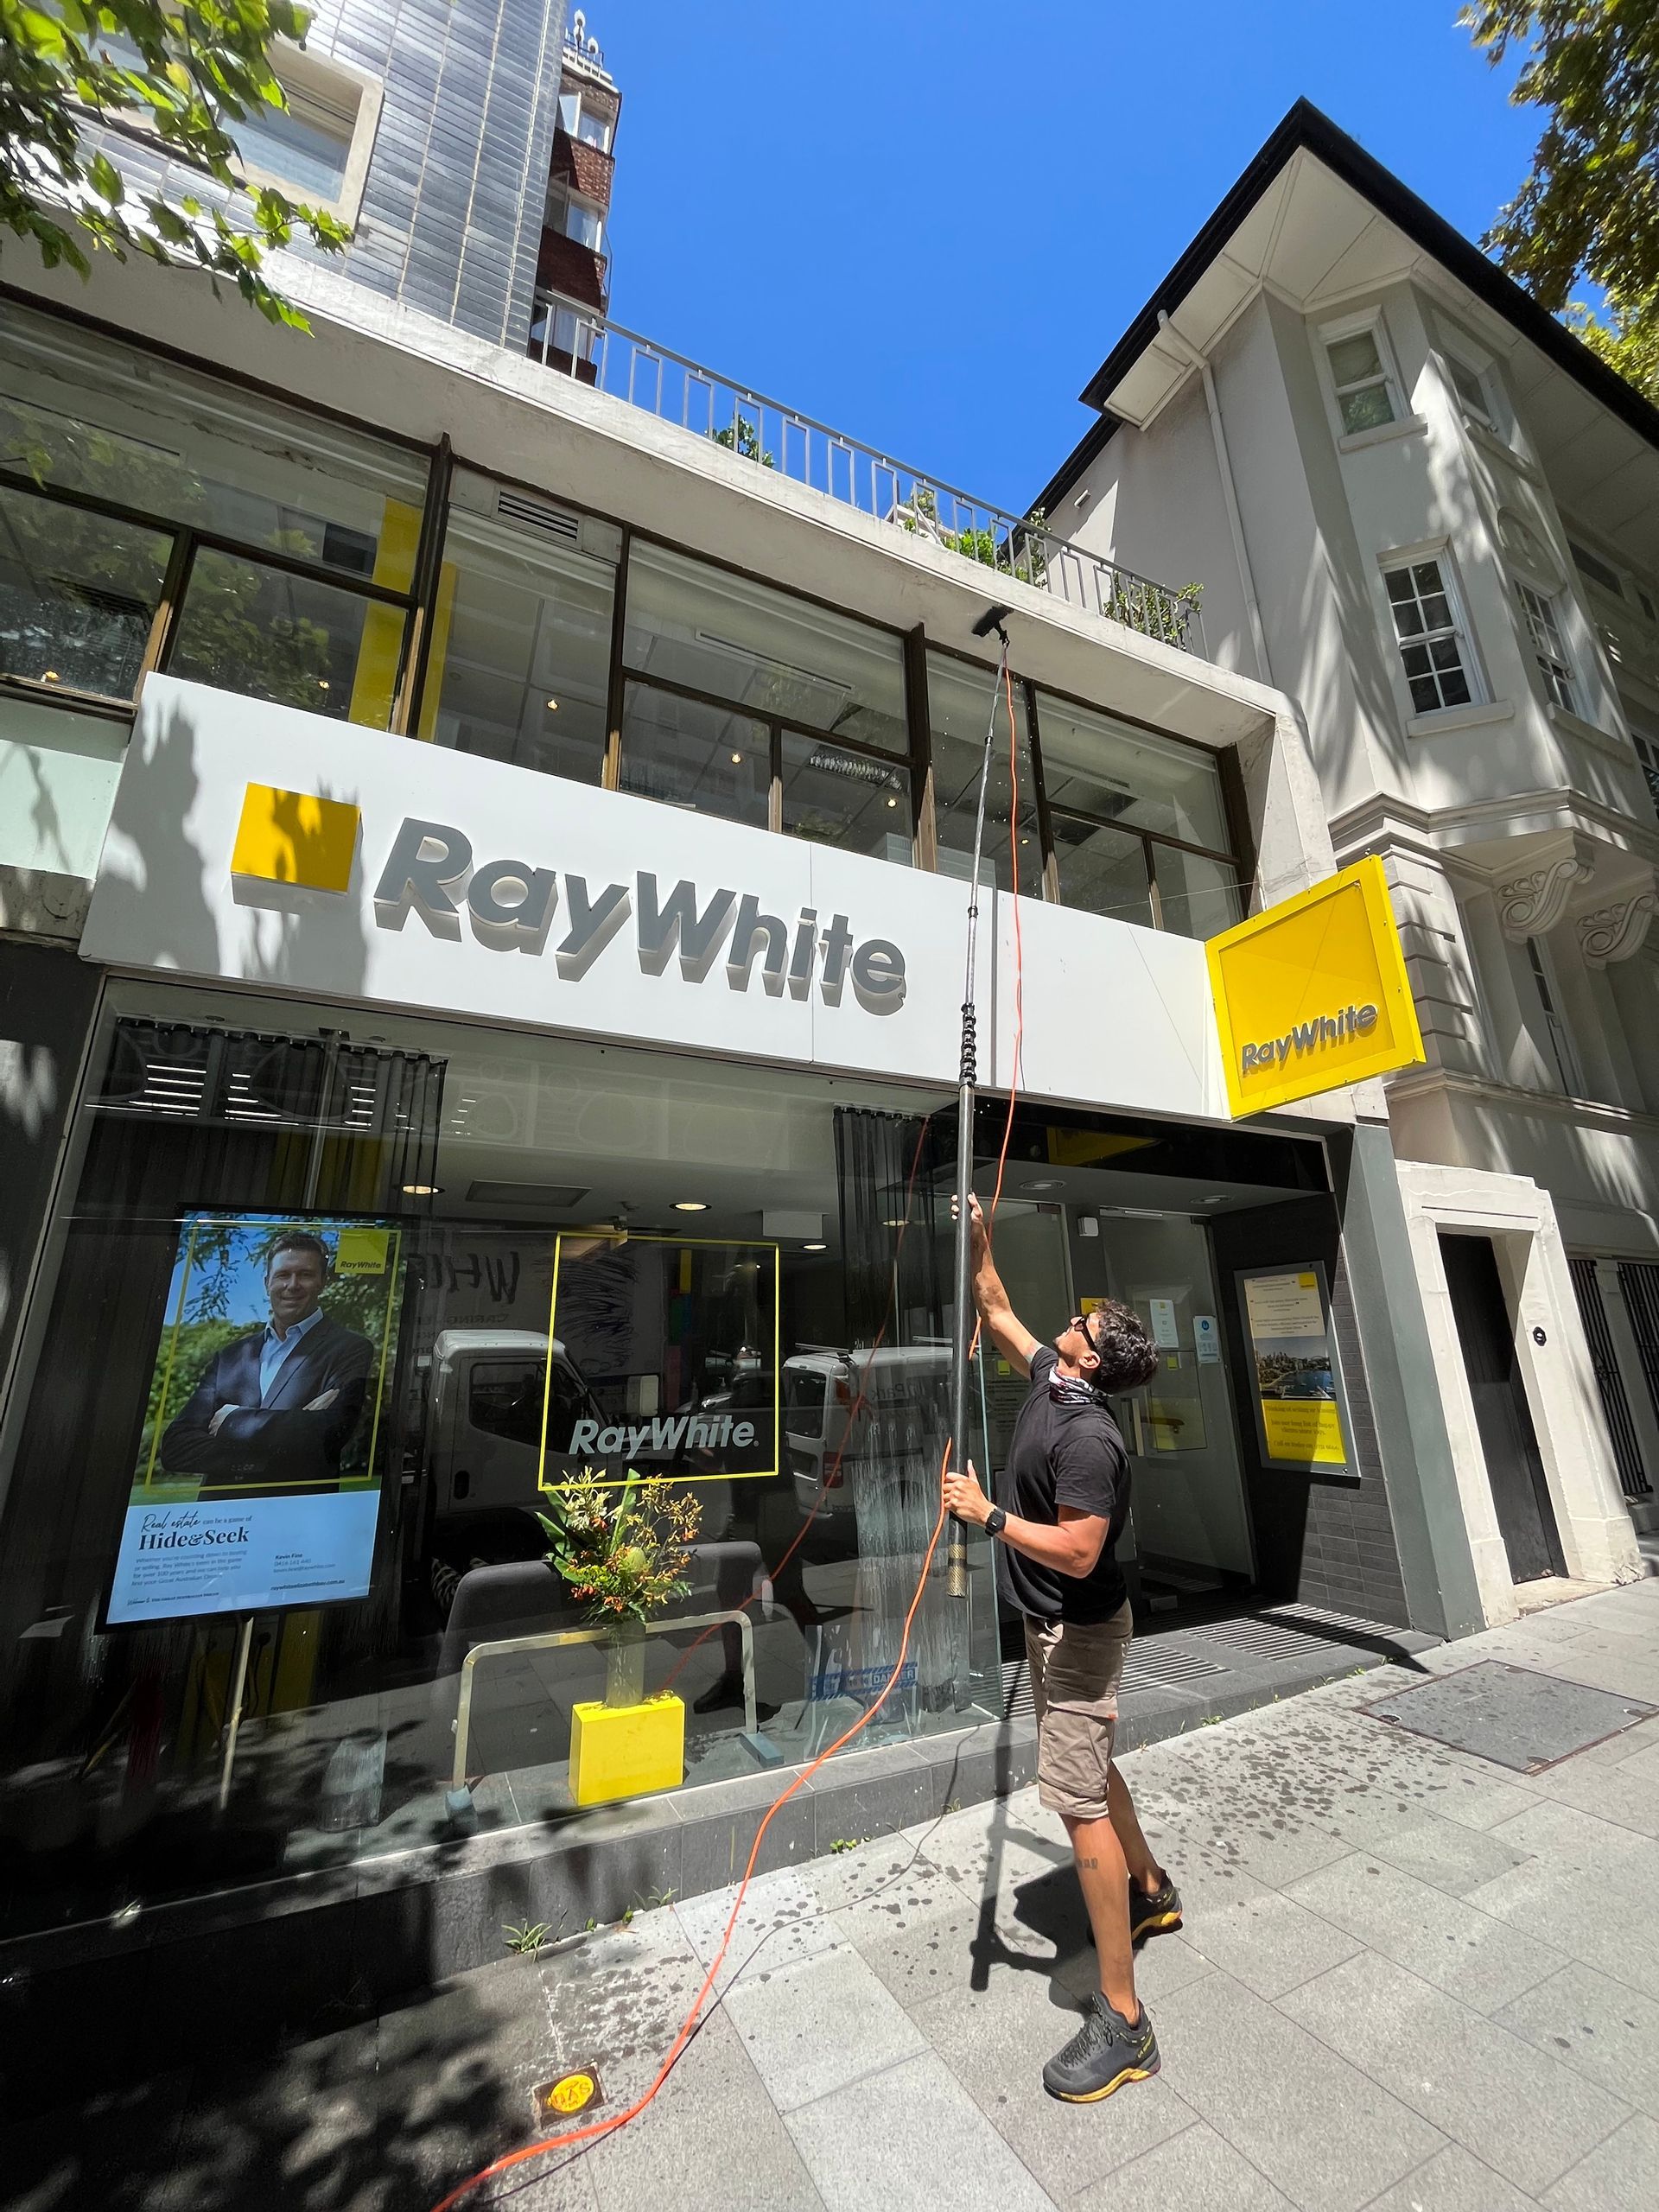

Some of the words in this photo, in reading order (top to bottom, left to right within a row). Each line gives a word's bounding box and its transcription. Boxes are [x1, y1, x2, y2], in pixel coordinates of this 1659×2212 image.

[374, 817, 907, 1001] RayWhite
[1242, 1004, 1377, 1072] RayWhite
[569, 1414, 755, 1460] RayWhite
[138, 1526, 249, 1551] Hide&Seek
[141, 1511, 170, 1533] Real
[171, 1511, 200, 1529] estate
